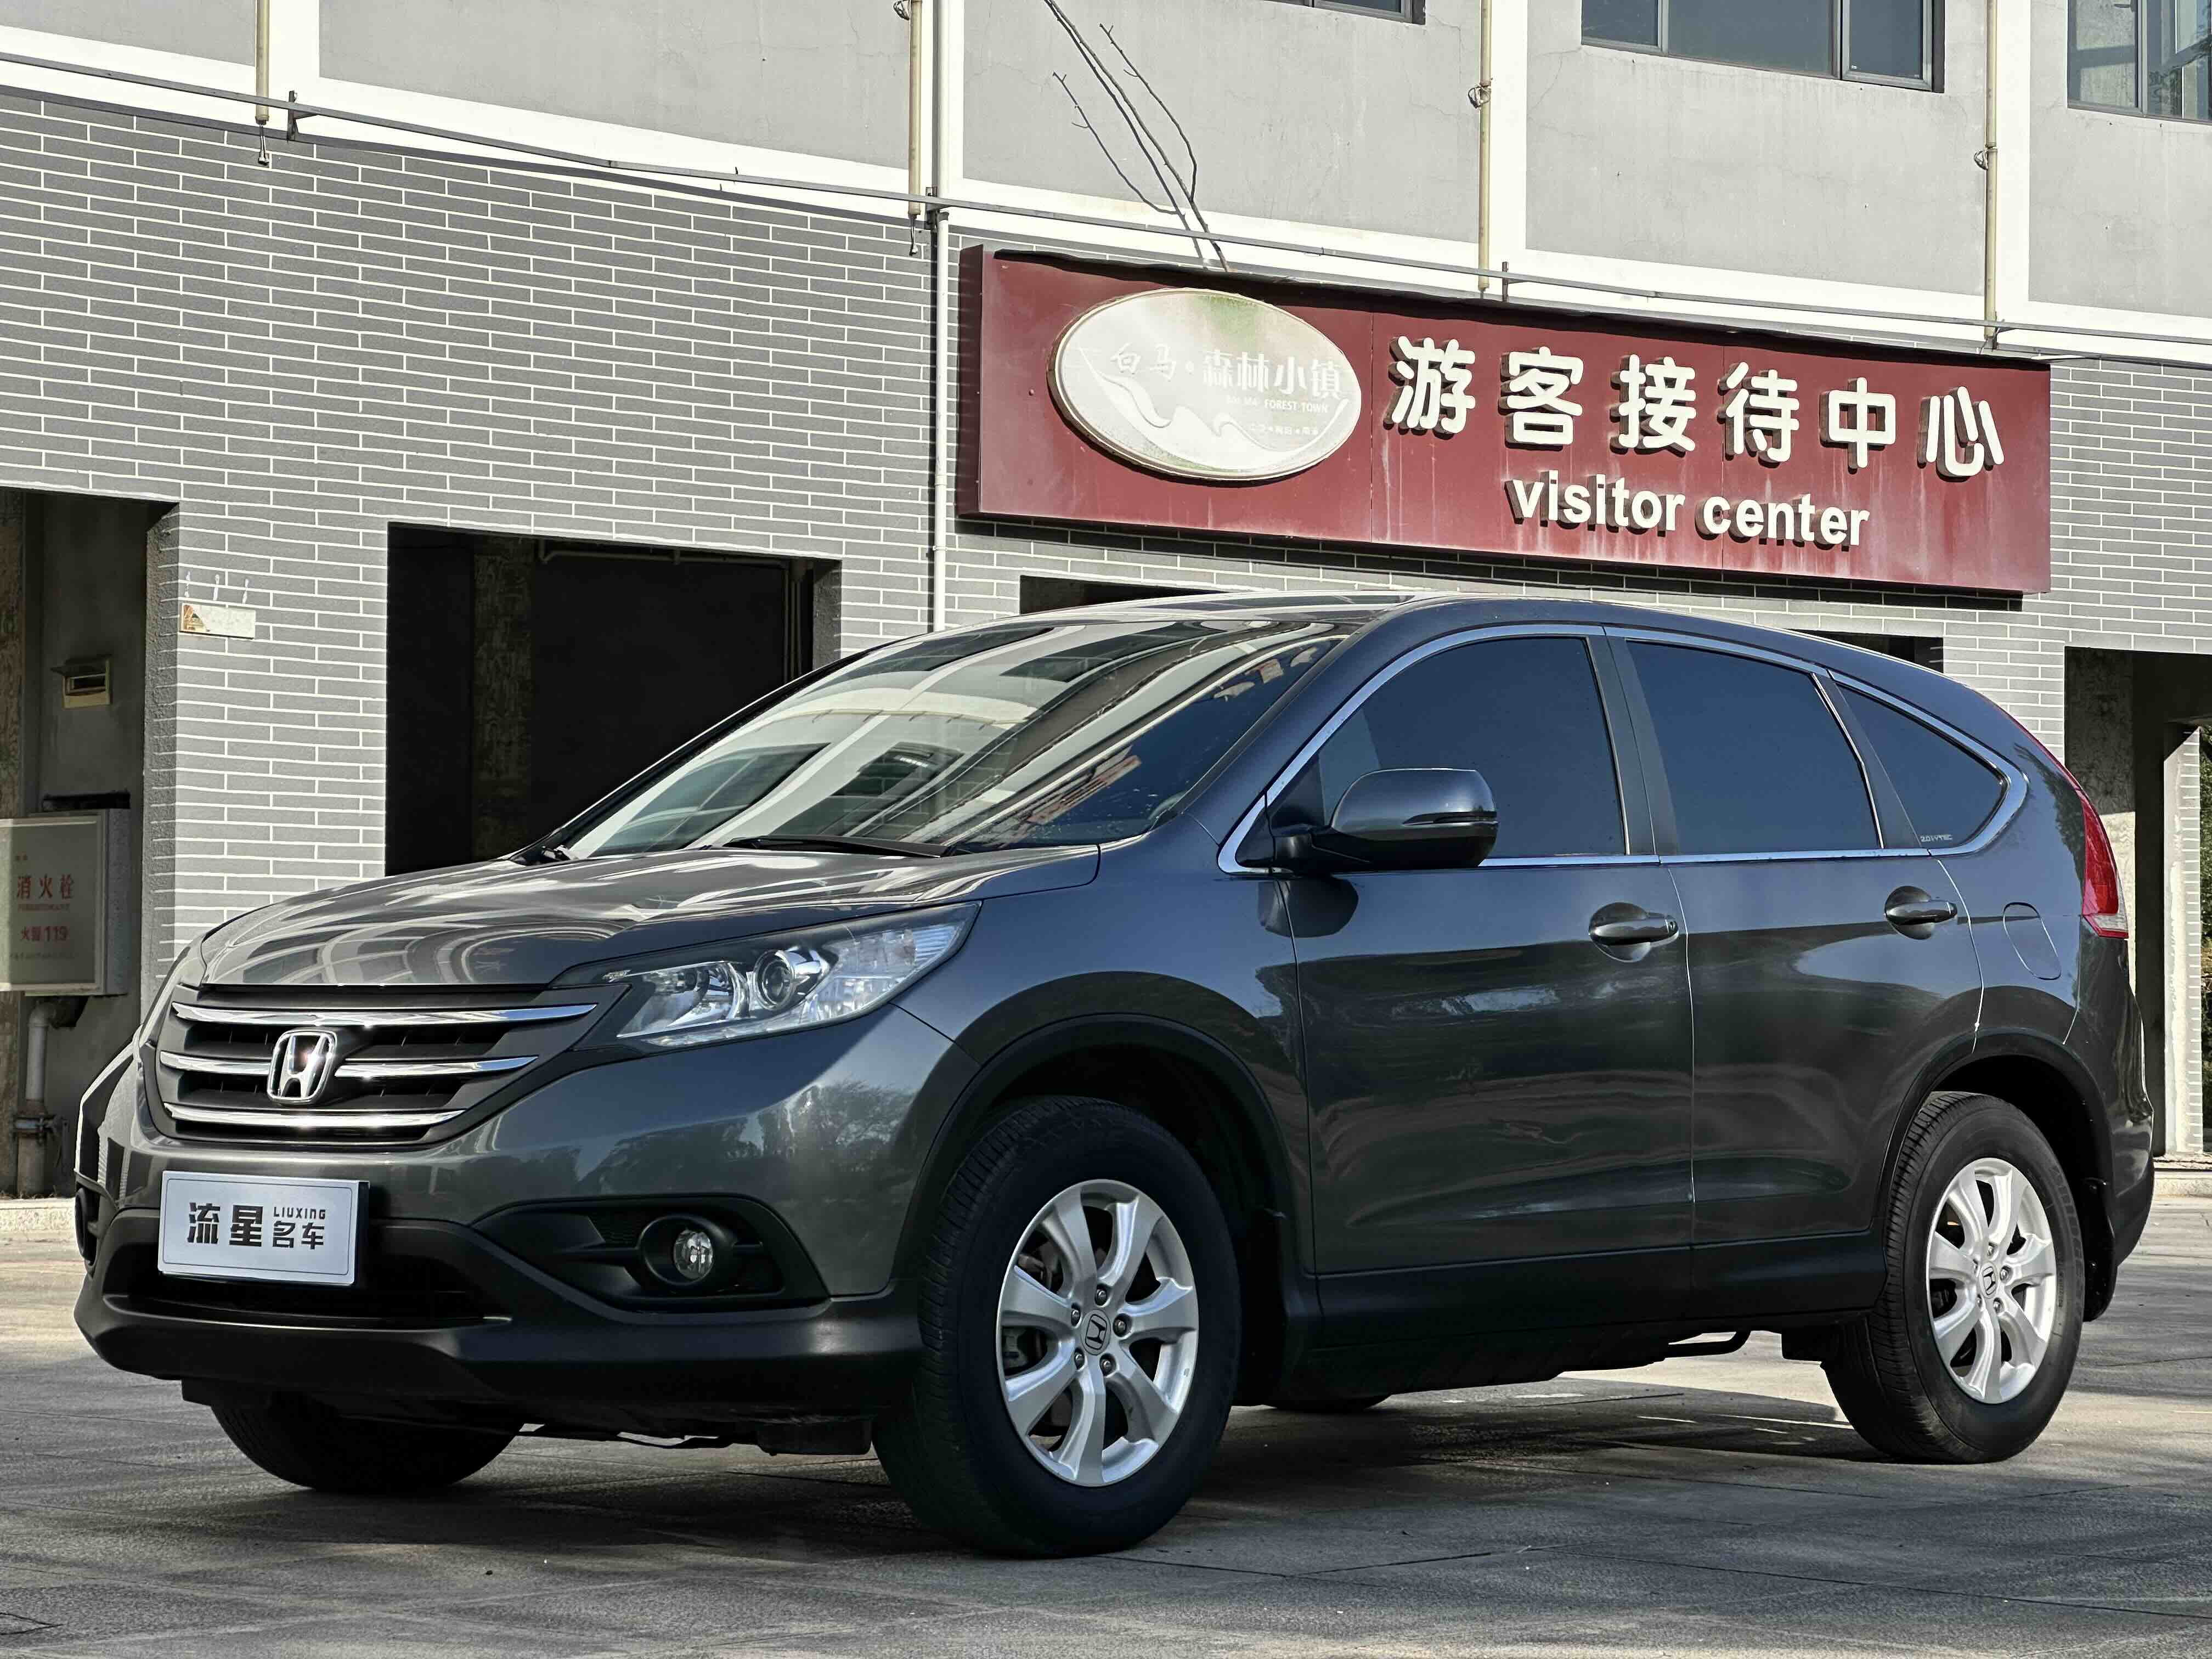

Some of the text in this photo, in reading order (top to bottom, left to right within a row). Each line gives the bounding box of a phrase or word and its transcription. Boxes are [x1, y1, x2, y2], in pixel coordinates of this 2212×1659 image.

[1263, 398, 1297, 410] FOREST
[1301, 402, 1328, 413] TOWN
[1390, 335, 2006, 477] 游客接待中心
[1512, 469, 1870, 546] visitor center
[17, 874, 75, 900] 消火栓
[273, 1206, 326, 1220] LIUXING
